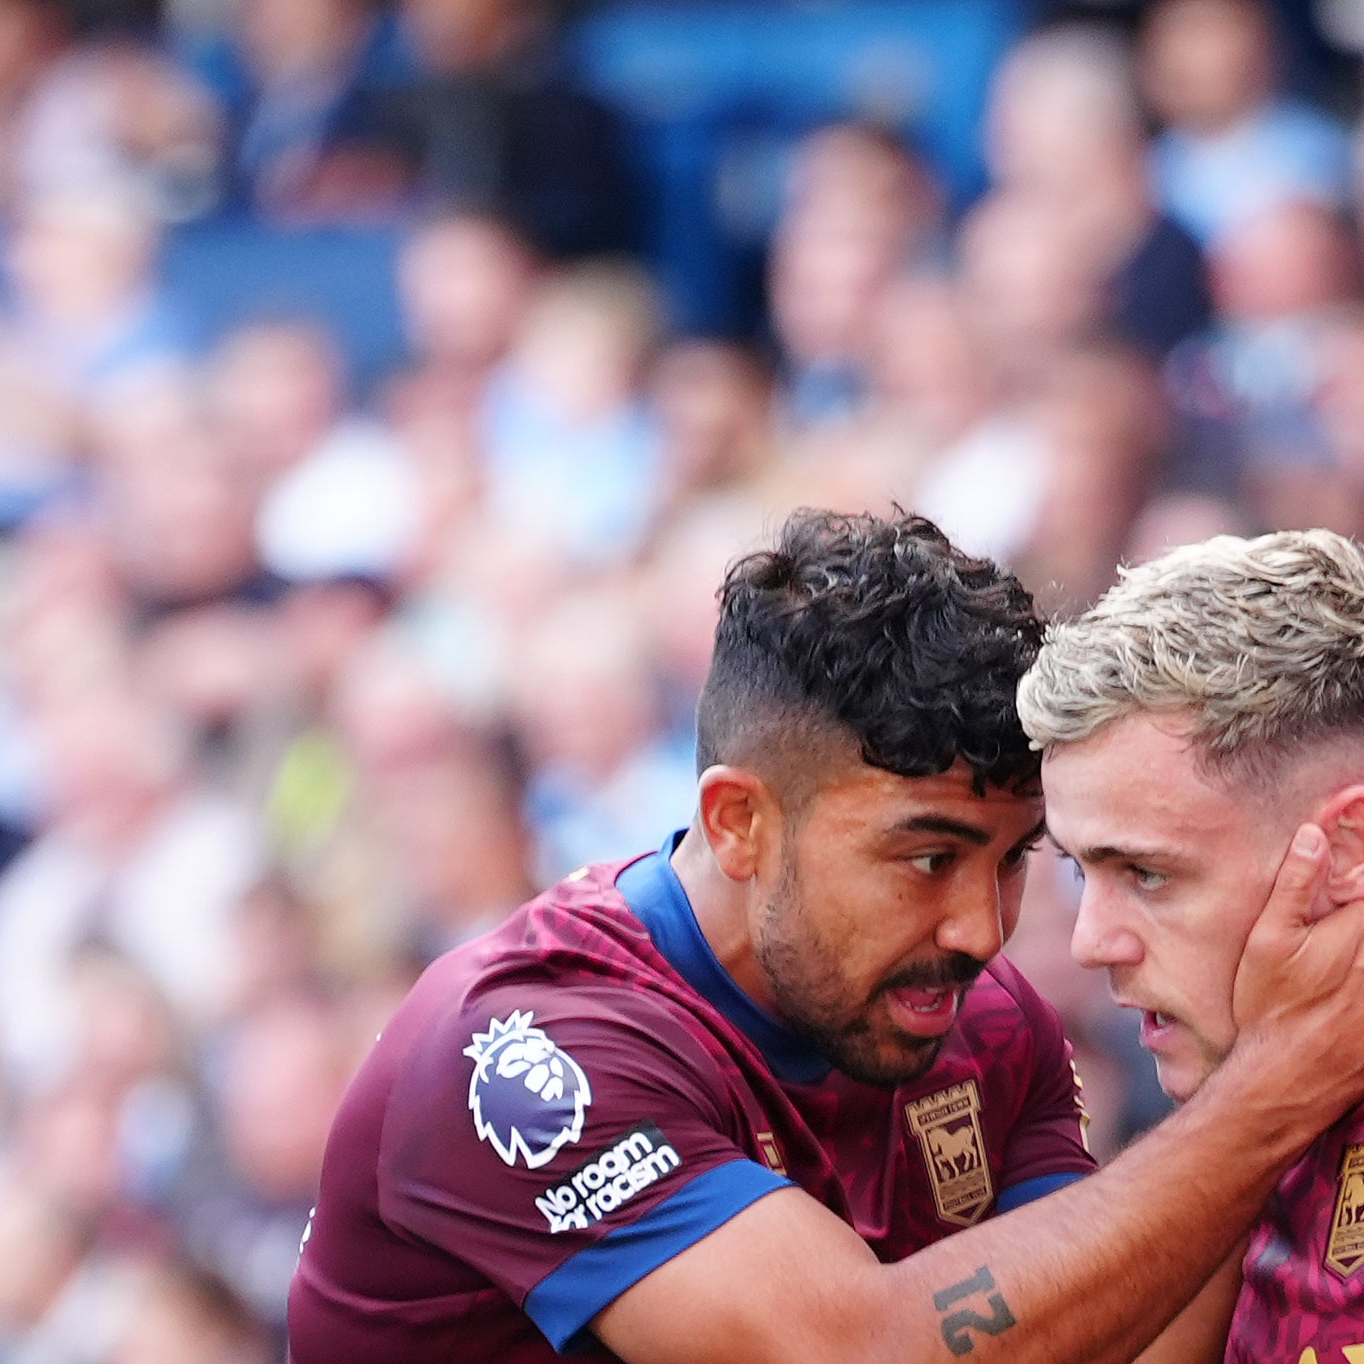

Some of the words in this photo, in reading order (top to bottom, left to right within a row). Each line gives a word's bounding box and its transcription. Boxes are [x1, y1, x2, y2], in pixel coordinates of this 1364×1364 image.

[535, 1186, 577, 1222] No
[571, 1132, 653, 1199] room
[586, 1145, 680, 1221] racism
